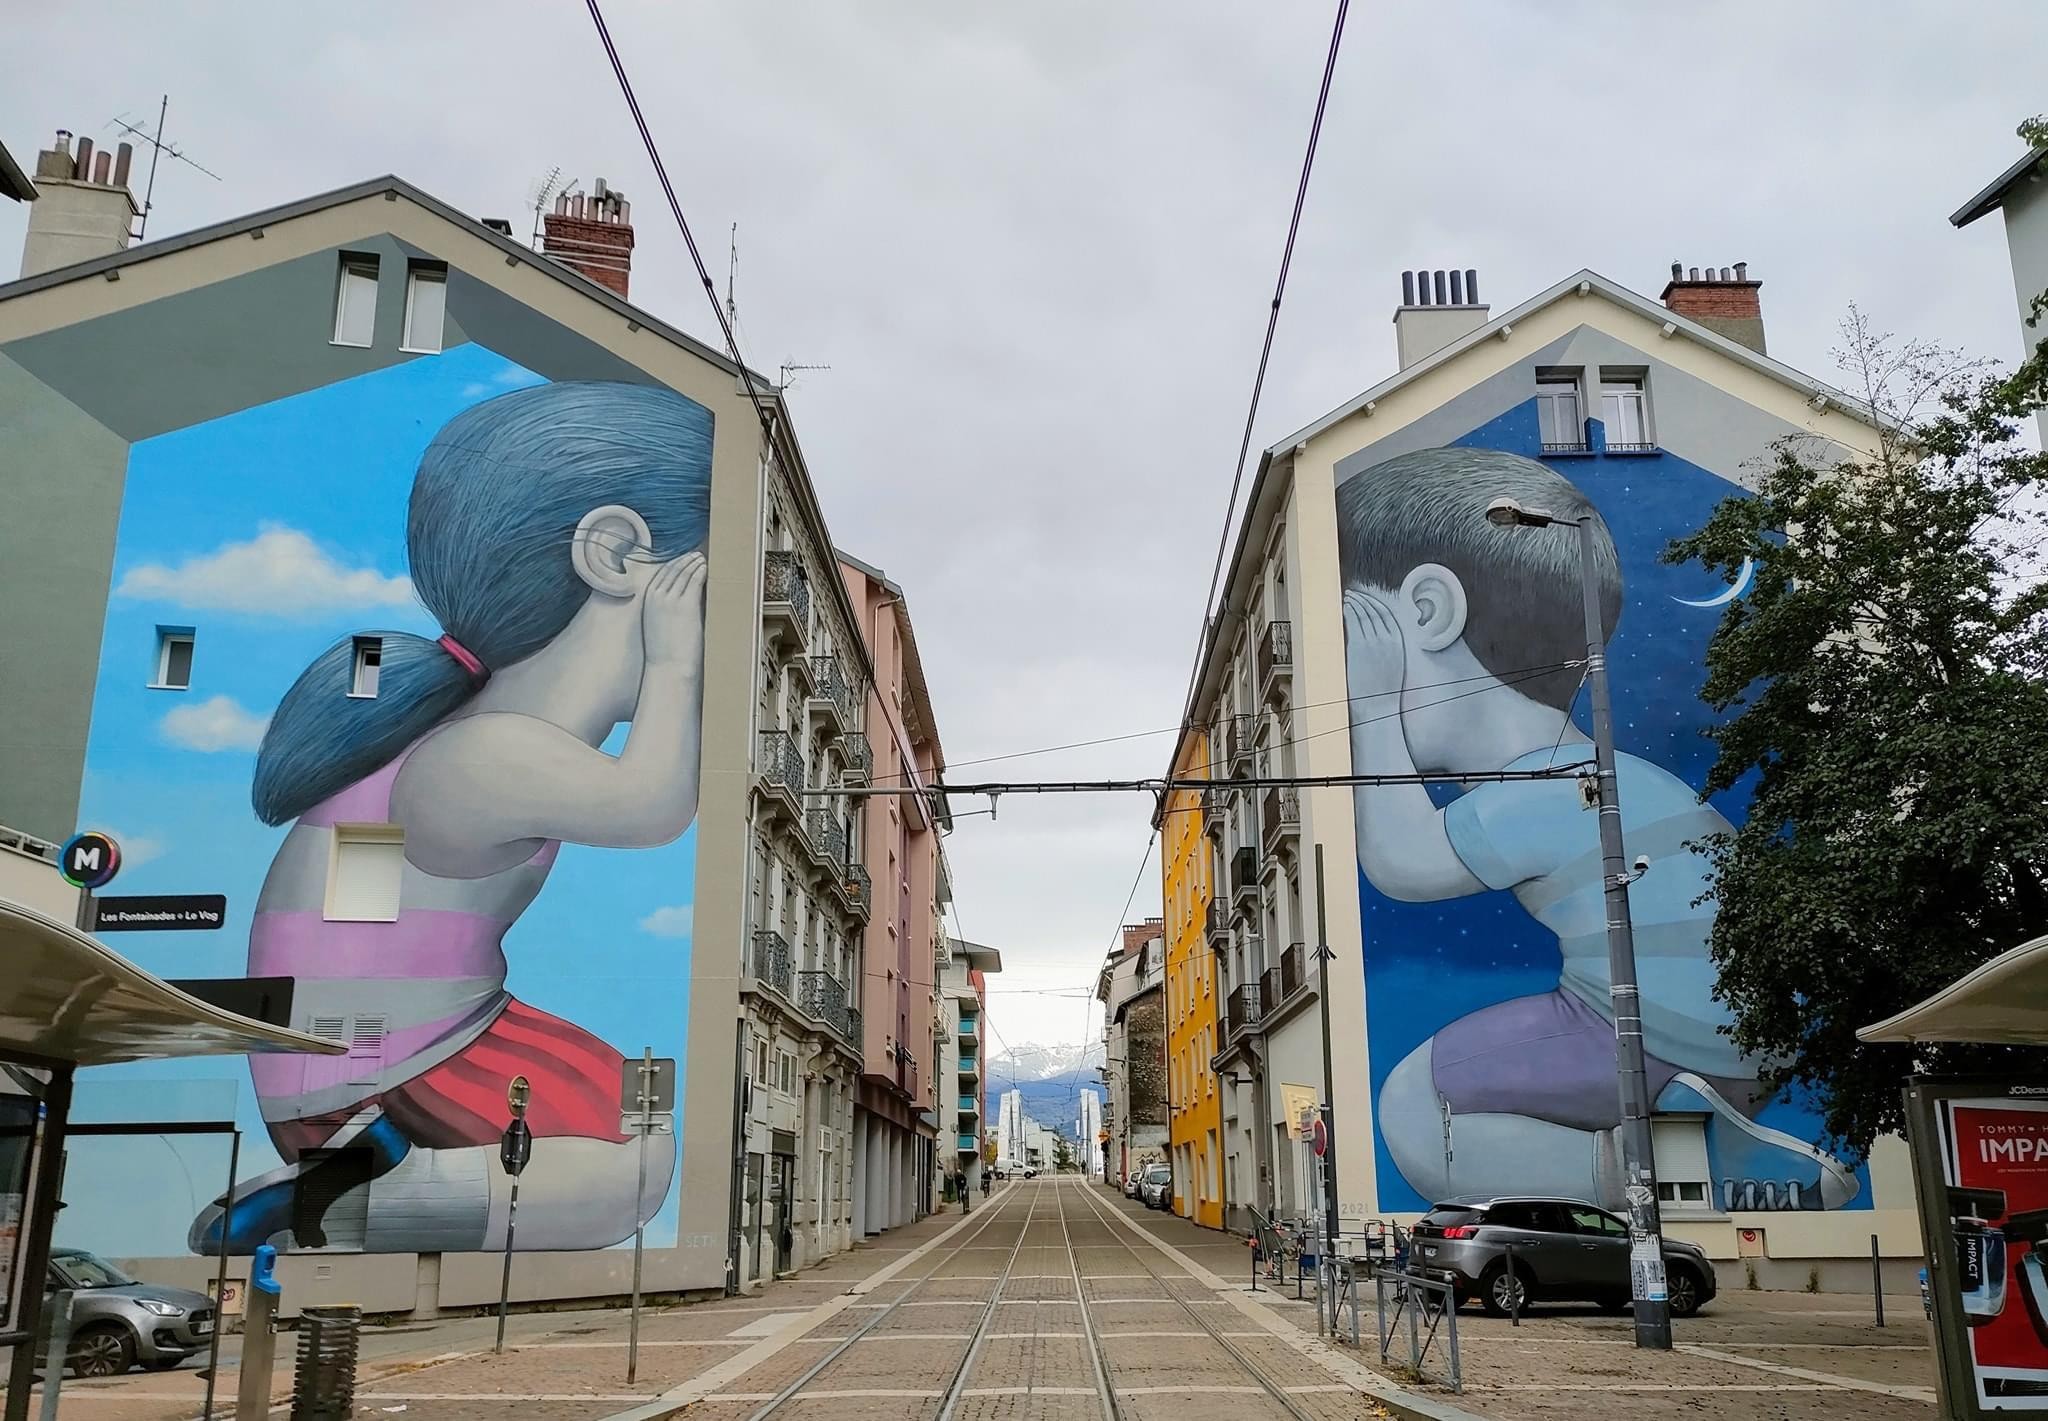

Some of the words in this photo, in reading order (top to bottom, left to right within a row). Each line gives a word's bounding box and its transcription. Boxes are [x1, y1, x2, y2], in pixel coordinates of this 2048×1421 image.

[73, 847, 100, 871] M
[101, 912, 118, 922] Les
[119, 911, 177, 922] Fontainades
[185, 911, 198, 920] Le
[199, 910, 219, 921] Vog
[1978, 1125, 2025, 1134] TOMMY
[1979, 1138, 2048, 1163] IMPA
[1967, 1238, 1979, 1279] IMPACT
